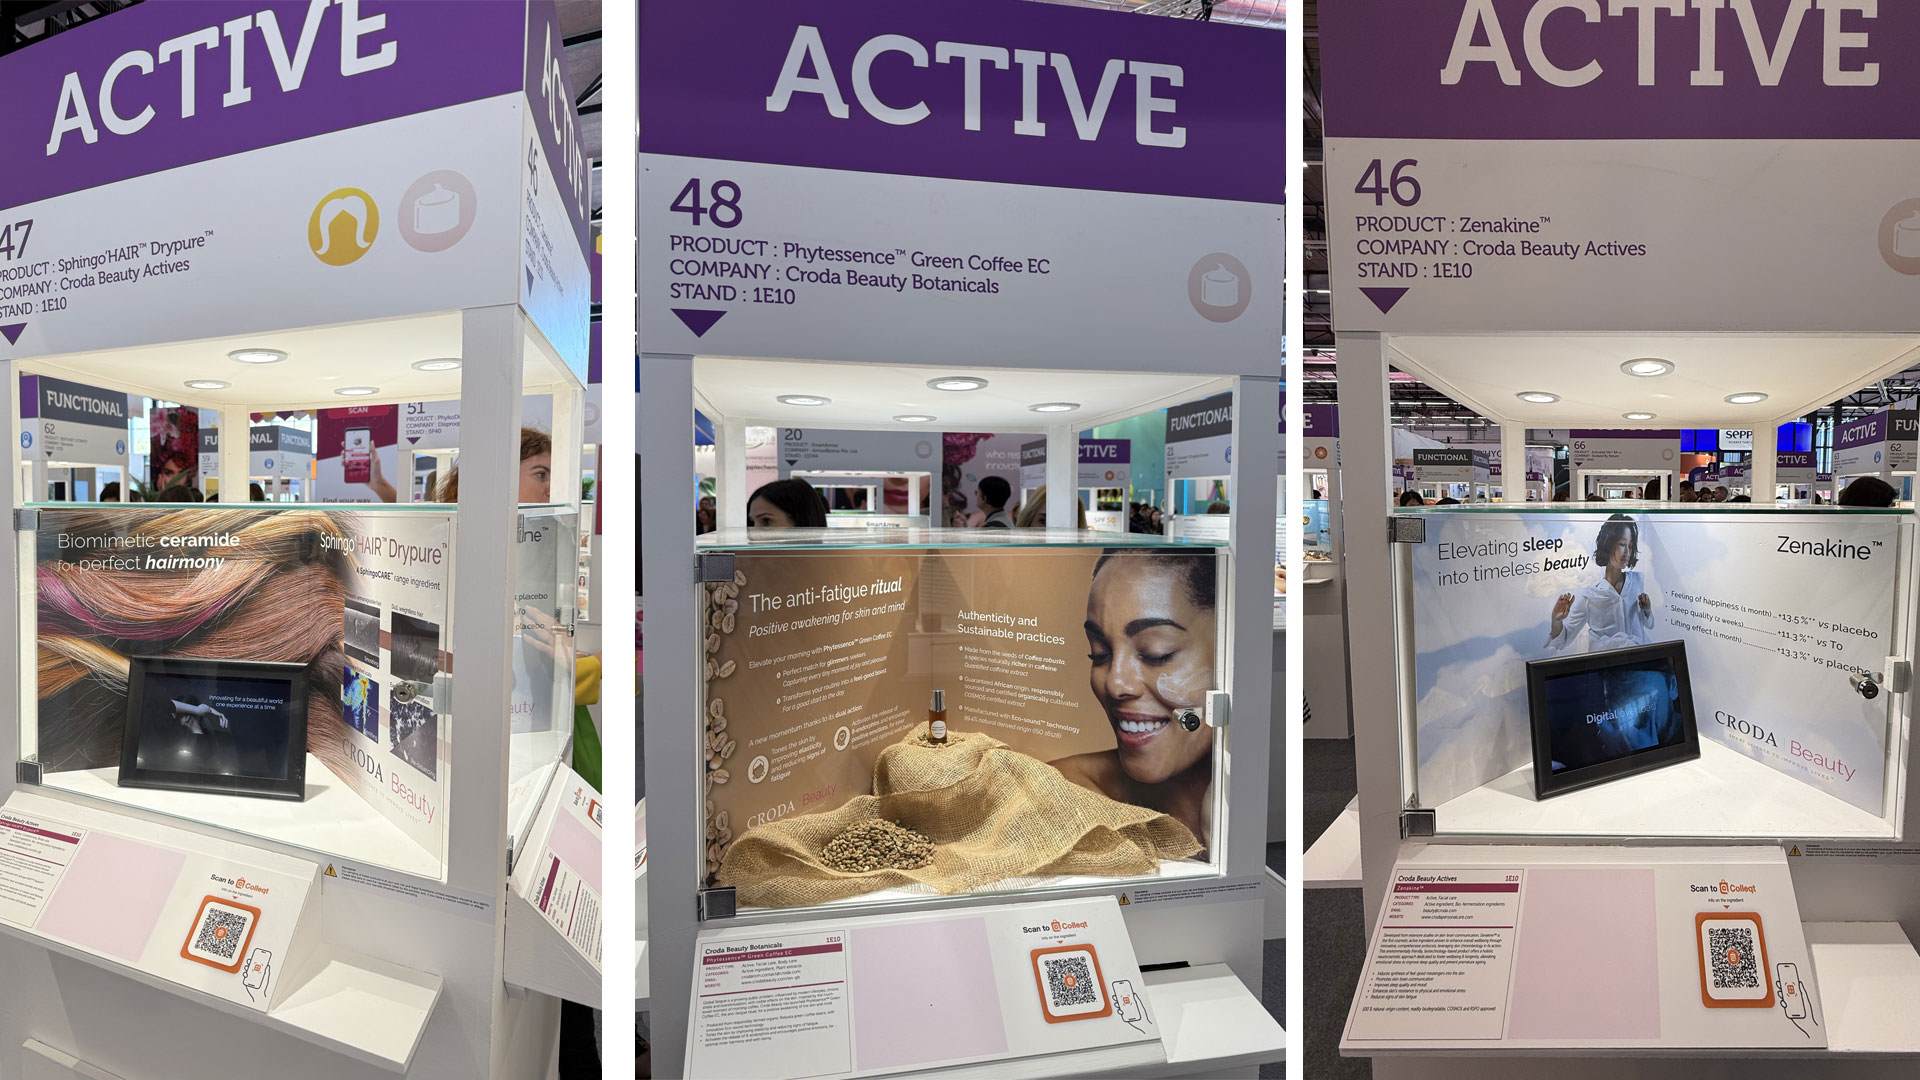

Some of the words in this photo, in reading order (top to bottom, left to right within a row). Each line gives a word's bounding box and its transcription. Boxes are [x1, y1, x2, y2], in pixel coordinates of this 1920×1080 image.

[1440, 0, 1880, 87] ACTIVE
[46, 0, 397, 156] ACTIVE
[766, 25, 1186, 148] ACTIVE
[542, 21, 584, 220] ACTIVE
[527, 137, 538, 196] 46
[1354, 159, 1421, 207] 46
[670, 178, 743, 229] 48
[1355, 216, 1446, 232] PRODUCT
[1460, 216, 1551, 233] Zenakine™
[0, 219, 33, 260] 47
[1356, 239, 1450, 255] COMPANY
[1463, 240, 1516, 256] Croda
[1520, 240, 1580, 260] Beauty
[1583, 240, 1647, 256] Actives
[670, 235, 768, 257] PRODUCT
[911, 251, 964, 270] Green
[968, 255, 1023, 273] Coffee
[1028, 258, 1050, 275] EC
[60, 275, 95, 291] Croda
[99, 268, 141, 285] Beauty
[143, 259, 190, 278] Actives
[670, 259, 772, 280] COMPANY
[786, 266, 841, 286] Croda
[846, 270, 907, 291] Beauty
[912, 274, 999, 294] Botanicals
[1357, 262, 1418, 279] STAND
[1432, 262, 1473, 279] 1E10
[41, 296, 68, 312] 1E10
[670, 283, 737, 301] STAND
[753, 287, 796, 305] 1E10
[46, 391, 123, 417] FUNCTIONAL
[407, 402, 425, 414] 51
[44, 423, 56, 434] 62
[784, 428, 803, 440] 20
[1841, 421, 1877, 444] ACTIVE
[1573, 441, 1586, 449] 66
[1890, 443, 1902, 452] 62
[1417, 453, 1469, 461] FUNCTIONAL
[57, 533, 155, 549] Biomimetic
[159, 532, 240, 548] ceramide
[1438, 539, 1518, 560] Elevating
[1522, 536, 1563, 552] sleep
[1777, 535, 1883, 560] Zenakine™
[57, 559, 77, 571] for
[79, 554, 141, 574] perfect
[145, 555, 225, 571] hairmony
[1438, 571, 1469, 586] into
[1473, 560, 1540, 582] timeless
[1543, 553, 1590, 572] beauty
[411, 576, 441, 591] ingredient
[748, 593, 782, 613] The
[786, 584, 868, 608] anti-fatigue
[870, 576, 902, 596] ritual
[749, 621, 789, 638] Positive
[790, 613, 840, 630] awakening
[841, 609, 853, 624] for
[854, 607, 871, 619] skin
[872, 603, 887, 616] and
[887, 600, 906, 613] mind
[958, 609, 1016, 626] Authenticity
[1018, 616, 1038, 627] and
[1671, 590, 1694, 603] Feeling
[1702, 597, 1740, 611] happiness
[1747, 608, 1772, 618] month)
[1818, 621, 1829, 629] vs
[1832, 623, 1878, 640] placebo
[1671, 604, 1689, 615] Sleep
[1690, 609, 1714, 622] quality
[1816, 639, 1827, 647] vs
[958, 623, 1014, 639] Sustainable
[1016, 632, 1065, 645] practices
[1670, 618, 1691, 630] Lifting
[1692, 624, 1713, 635] effect
[1719, 632, 1742, 643] month)
[1813, 656, 1824, 665] vs
[773, 656, 786, 665] your
[1586, 710, 1618, 725] Digital
[1715, 711, 1778, 747] CRODA
[1790, 740, 1856, 782] Beauty
[342, 739, 384, 783] CRODA
[391, 772, 435, 824] Beauty
[747, 801, 795, 830] CRODA
[210, 874, 226, 883] Scan
[228, 878, 235, 886] to
[1417, 875, 1436, 883] Beauty
[1690, 884, 1709, 893] Scan
[1710, 884, 1718, 893] to
[1022, 926, 1041, 934] Scan
[749, 943, 783, 951] Botanicals
